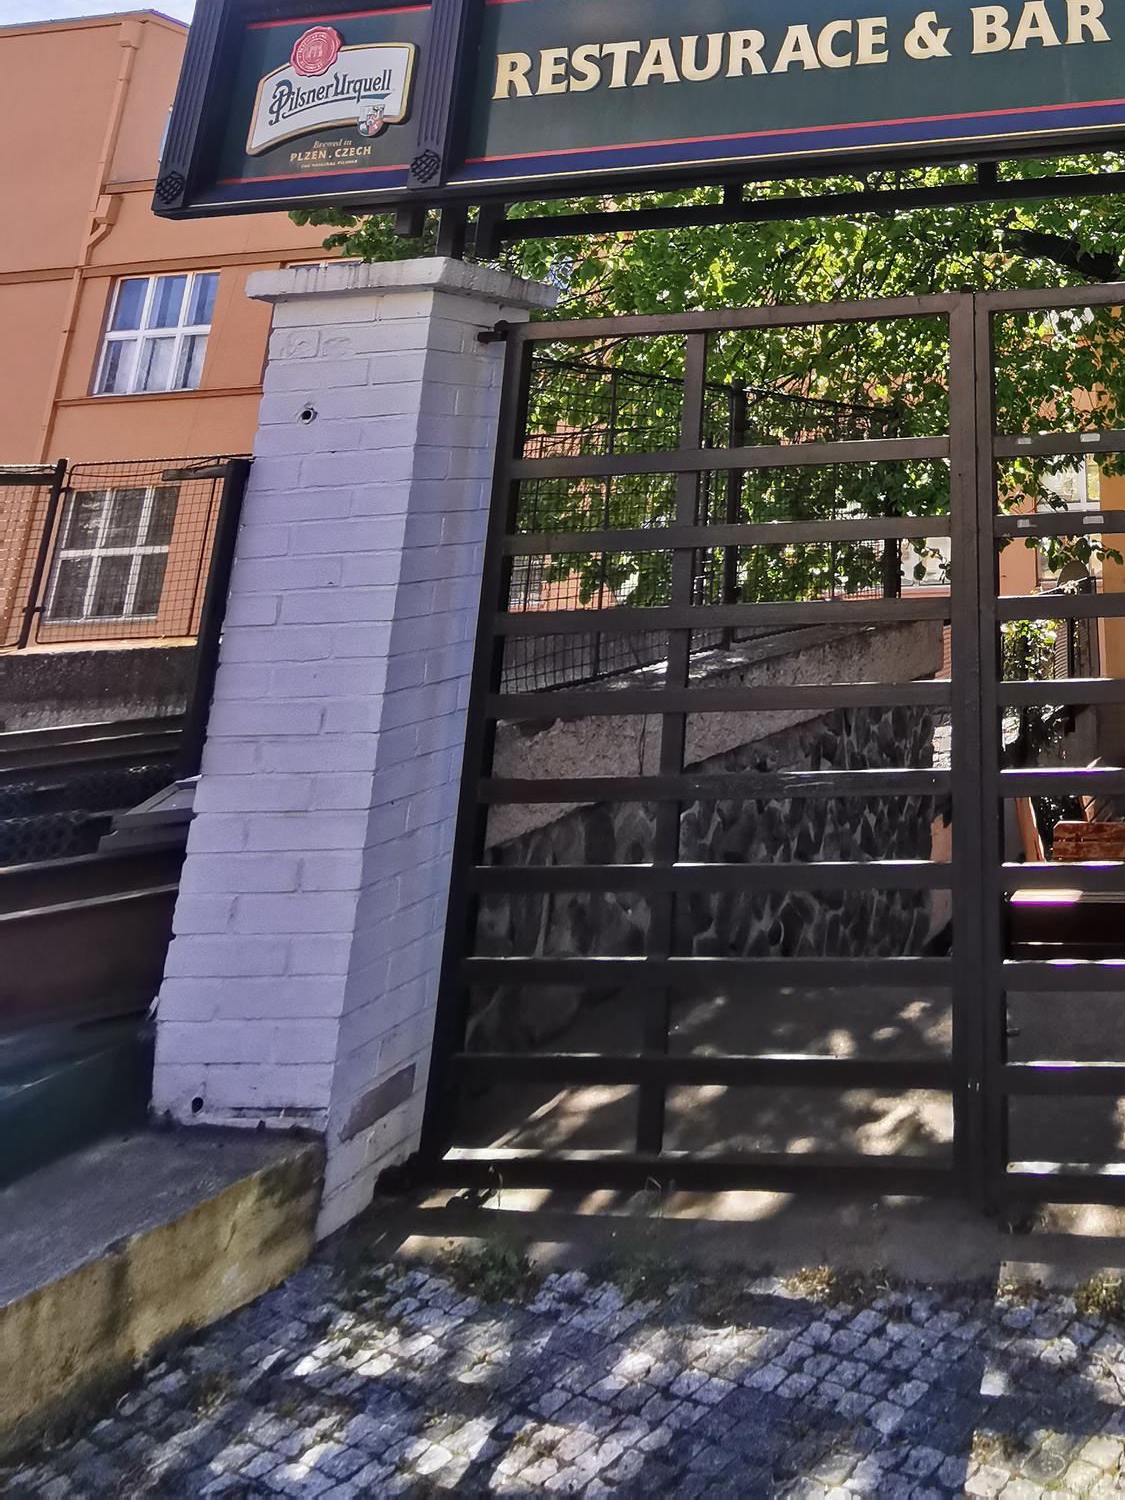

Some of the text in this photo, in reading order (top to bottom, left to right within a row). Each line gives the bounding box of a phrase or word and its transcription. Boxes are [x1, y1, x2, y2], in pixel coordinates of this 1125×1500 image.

[491, 15, 889, 100] RESTAURACE
[903, 11, 953, 60] &
[268, 69, 392, 126] Pilsner Urquell
[334, 146, 372, 158] CZECH
